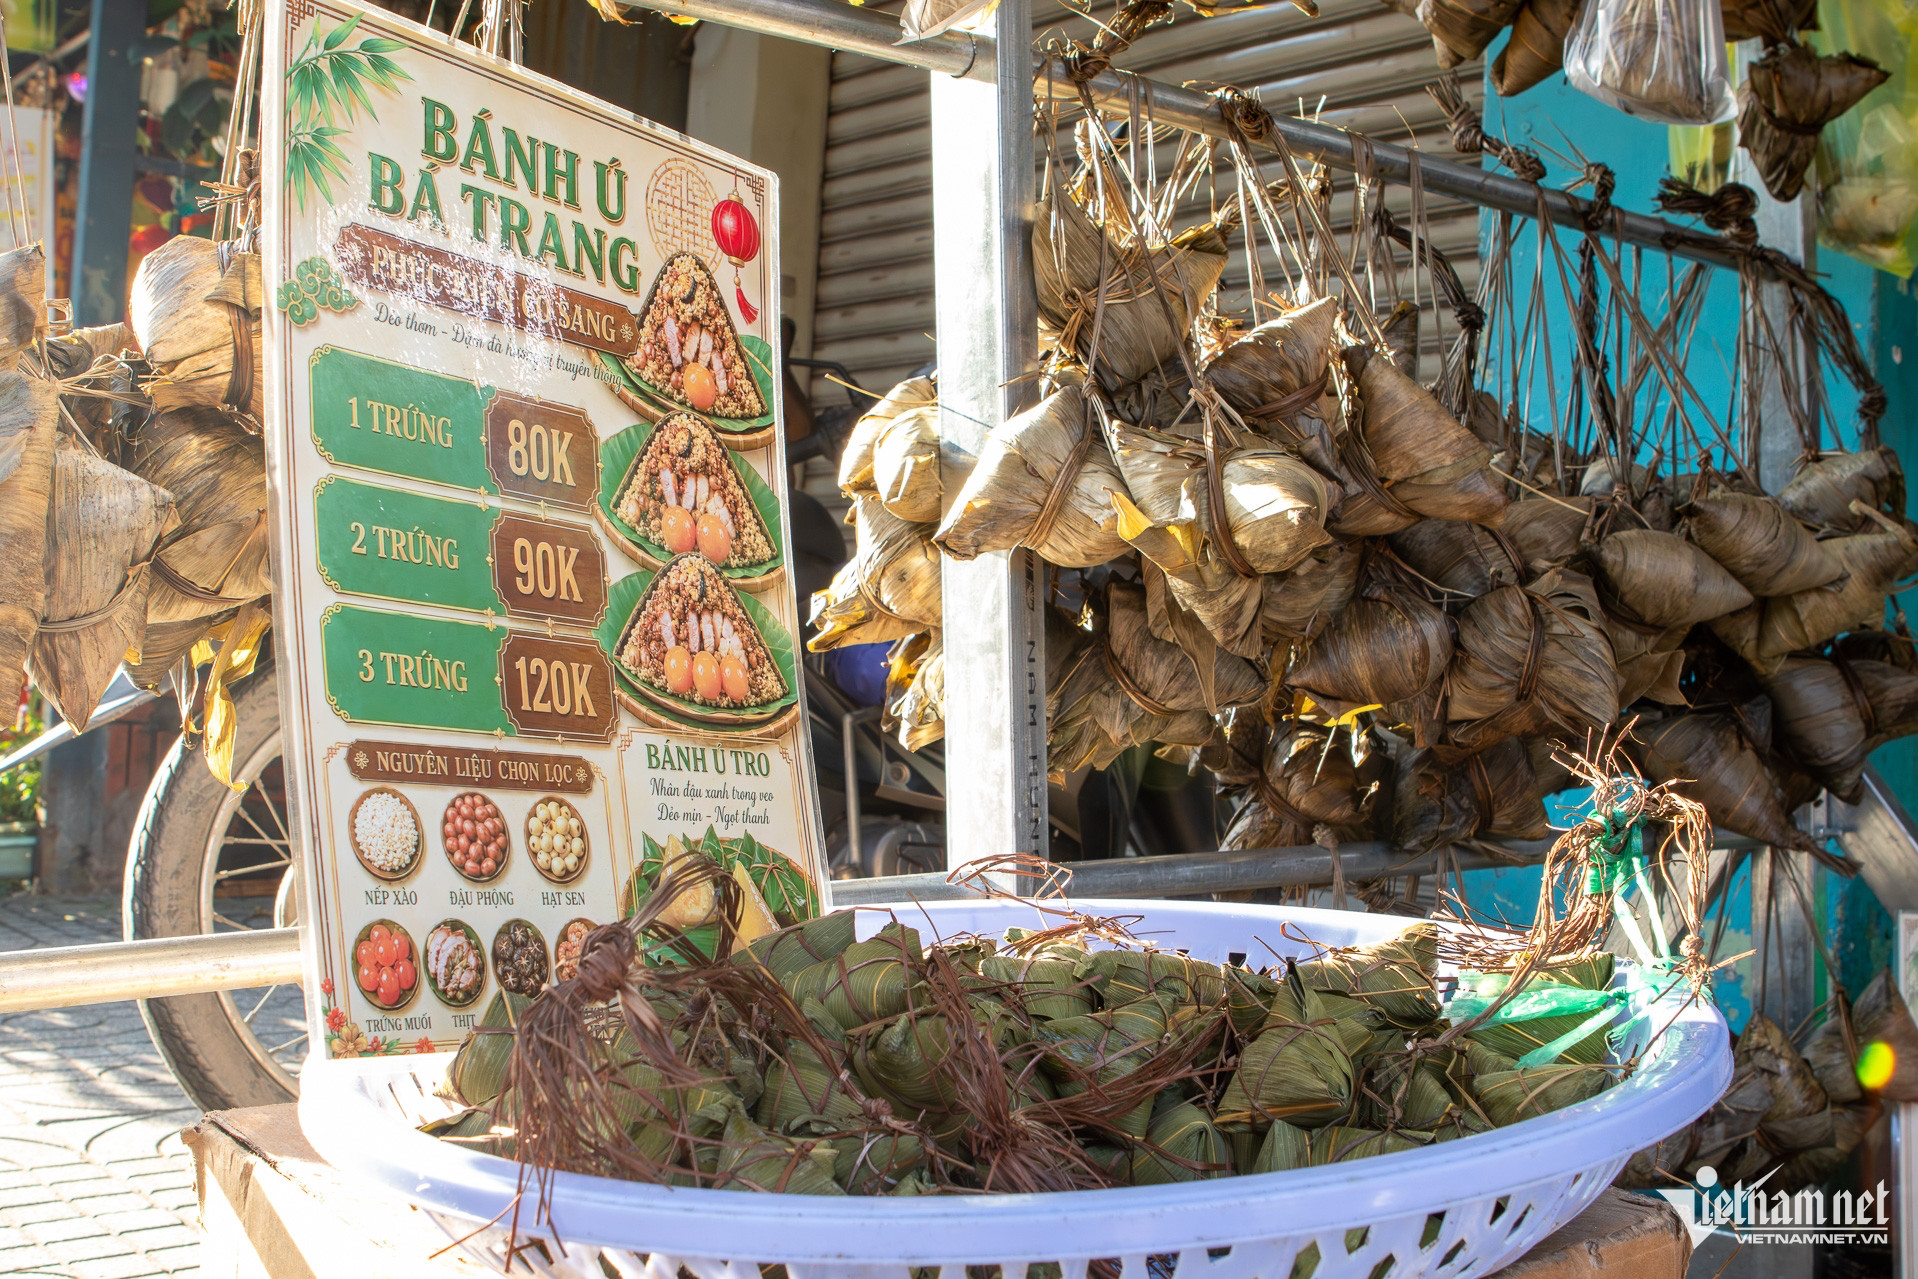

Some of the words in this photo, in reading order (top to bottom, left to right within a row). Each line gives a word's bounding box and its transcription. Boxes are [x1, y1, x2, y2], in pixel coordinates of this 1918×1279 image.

[421, 96, 583, 212] BÁNH
[593, 156, 628, 224] Ú
[367, 151, 450, 236] BÁ
[460, 182, 643, 296] TRANG
[558, 301, 617, 343] SANG
[374, 302, 403, 327] Dẻo
[405, 311, 438, 337] thơm
[487, 333, 504, 354] đà
[555, 356, 592, 382] truyền
[593, 364, 623, 393] thống
[348, 397, 361, 429] 1
[367, 399, 453, 449] TRỨNG
[508, 419, 576, 487] 80K
[351, 522, 367, 555] 2
[372, 525, 460, 571] TRỨNG
[513, 537, 583, 602] 90K
[358, 649, 375, 682] 3
[380, 650, 468, 693] TRỨNG
[515, 656, 598, 717] 120K
[376, 751, 449, 776] NGUYÊN
[455, 753, 492, 787] LIỆU
[498, 760, 541, 788] CHỌN
[545, 763, 573, 787] LỌC
[645, 739, 708, 773] BÁNH
[712, 744, 726, 774] Ú
[730, 750, 771, 777] TRO
[650, 777, 680, 797] Nhân
[683, 780, 703, 801] đậu
[705, 782, 729, 800] xanh
[732, 785, 757, 807] trong
[759, 792, 774, 801] veo
[657, 802, 681, 821] Dẻo
[682, 808, 703, 825] mịn
[714, 805, 740, 830] Ngọt
[742, 808, 771, 825] thanh
[1029, 755, 1041, 874] HUN
[364, 885, 390, 906] NẾP
[392, 891, 418, 905] XÀO
[449, 890, 475, 907] ĐẬU
[477, 891, 514, 907] PHỘNG
[541, 892, 563, 909] HẠT
[565, 892, 586, 906] SEN
[365, 1014, 403, 1033] TRỨNG
[404, 1012, 432, 1030] MUỐI
[452, 1014, 476, 1029] THỊT
